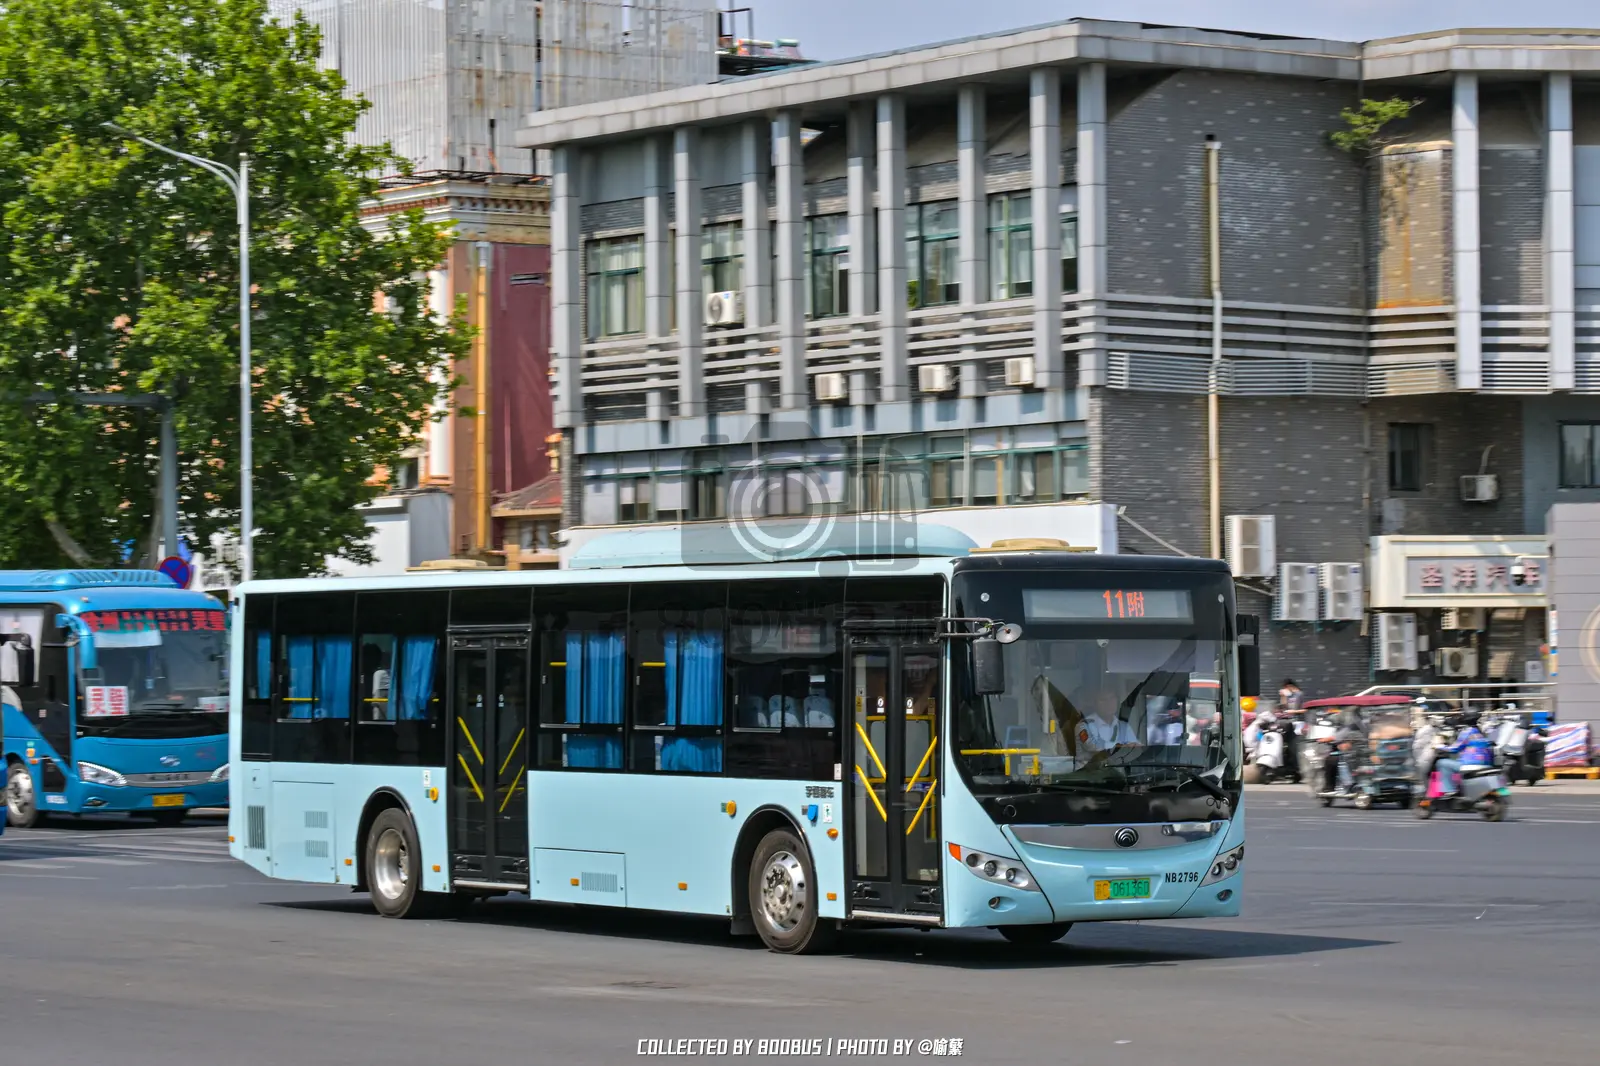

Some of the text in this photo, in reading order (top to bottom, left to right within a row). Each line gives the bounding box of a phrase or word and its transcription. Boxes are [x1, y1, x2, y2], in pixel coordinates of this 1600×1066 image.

[1420, 560, 1541, 589] 圣洋汽车
[1102, 590, 1145, 618] 11附
[1165, 871, 1199, 883] NB2796
